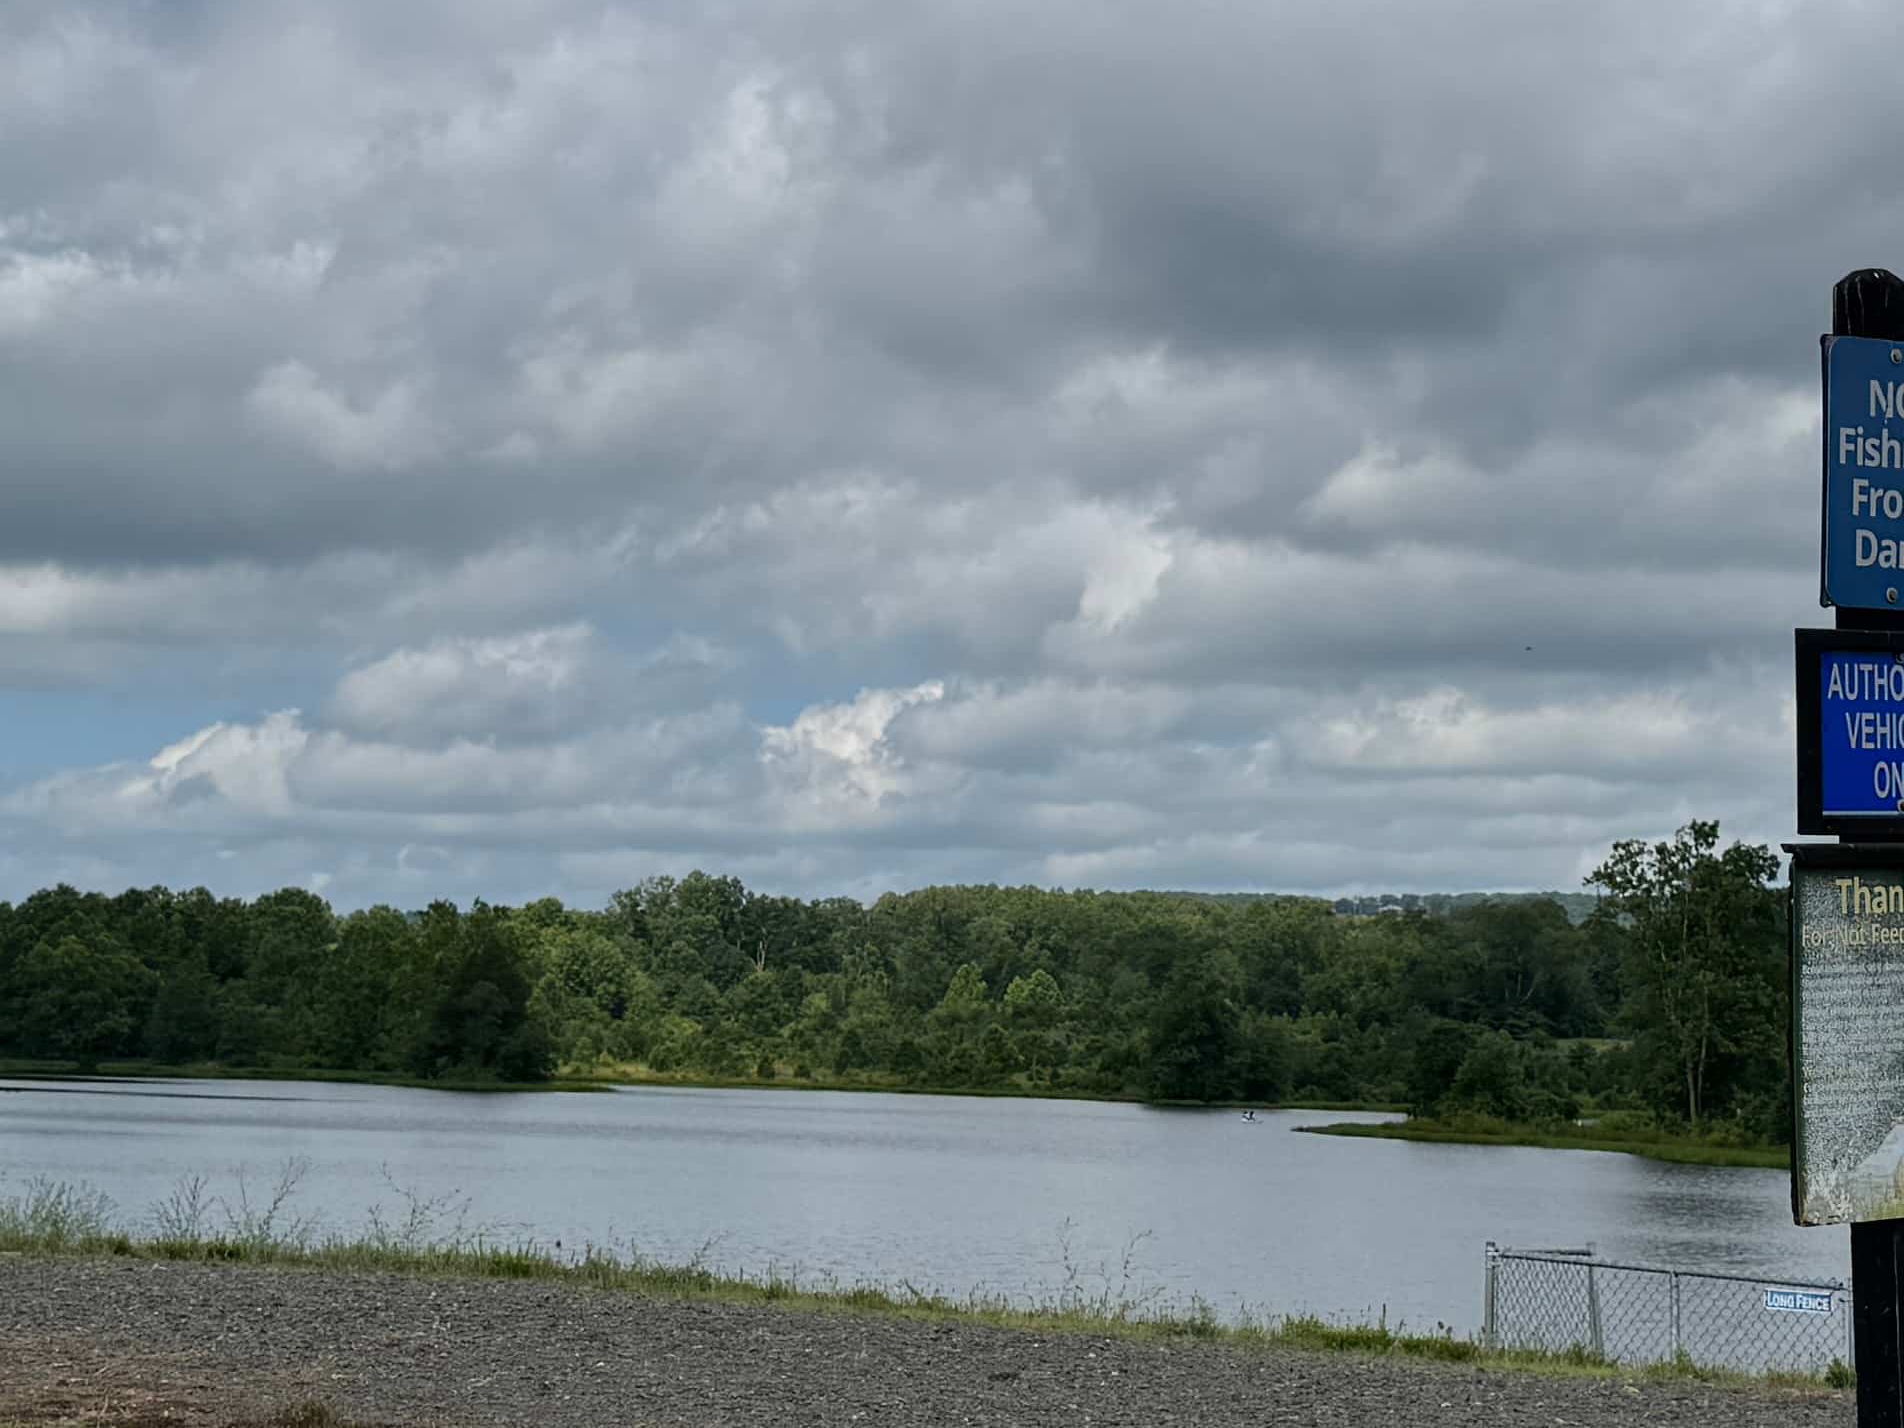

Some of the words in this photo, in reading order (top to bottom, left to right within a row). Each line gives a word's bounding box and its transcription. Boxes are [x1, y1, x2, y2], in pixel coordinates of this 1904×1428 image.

[1802, 924, 1827, 948] For
[1767, 1291, 1795, 1308] LONG
[1796, 1294, 1830, 1311] FENCE
